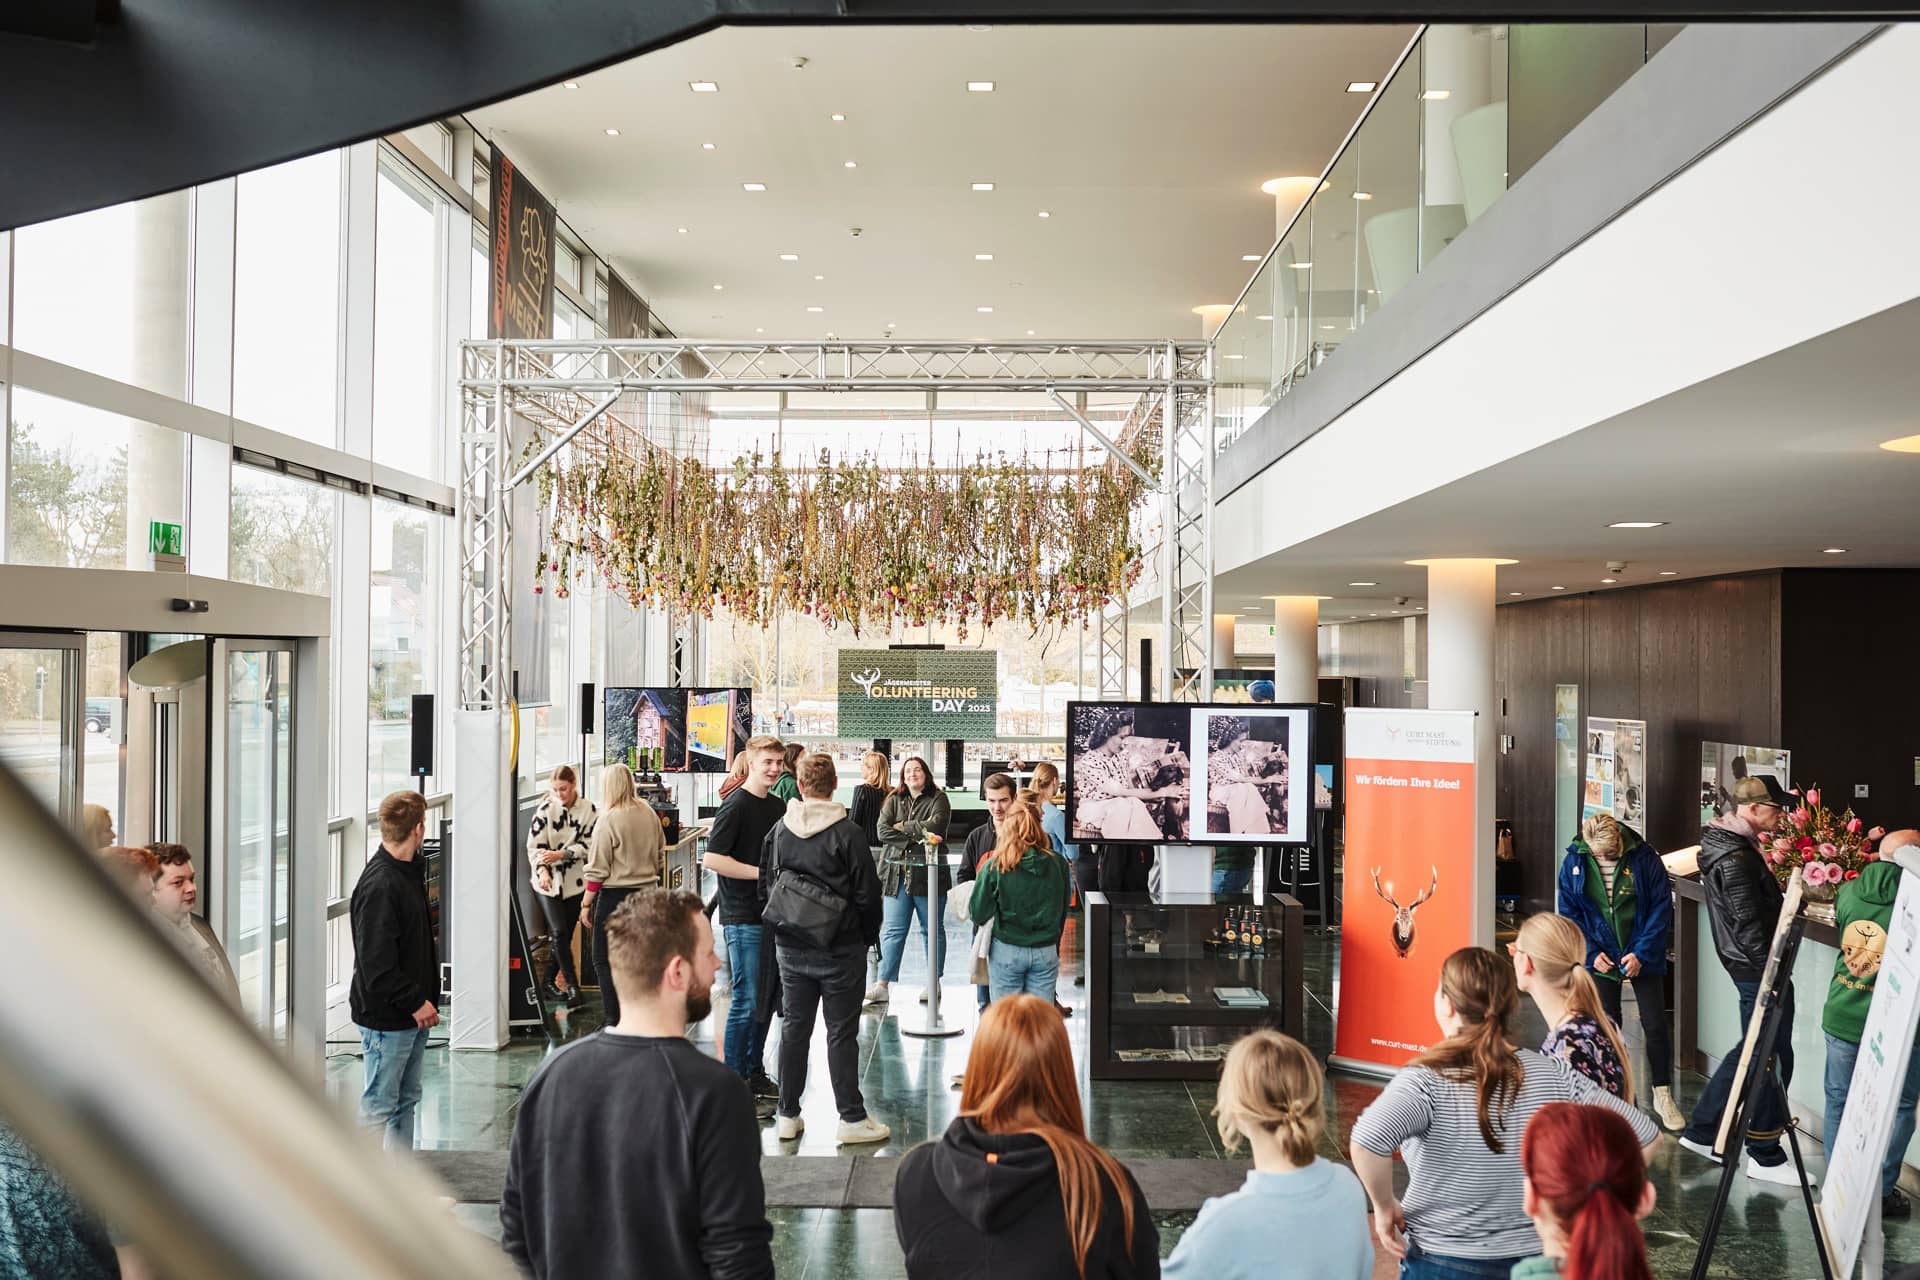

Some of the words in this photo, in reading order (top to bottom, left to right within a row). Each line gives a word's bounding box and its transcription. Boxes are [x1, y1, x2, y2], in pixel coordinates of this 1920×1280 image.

[932, 700, 965, 712] DAY
[1355, 775, 1371, 785] Wir
[1373, 775, 1408, 787] fördern
[1410, 778, 1431, 788] Ihre
[1433, 779, 1460, 790] Idee!
